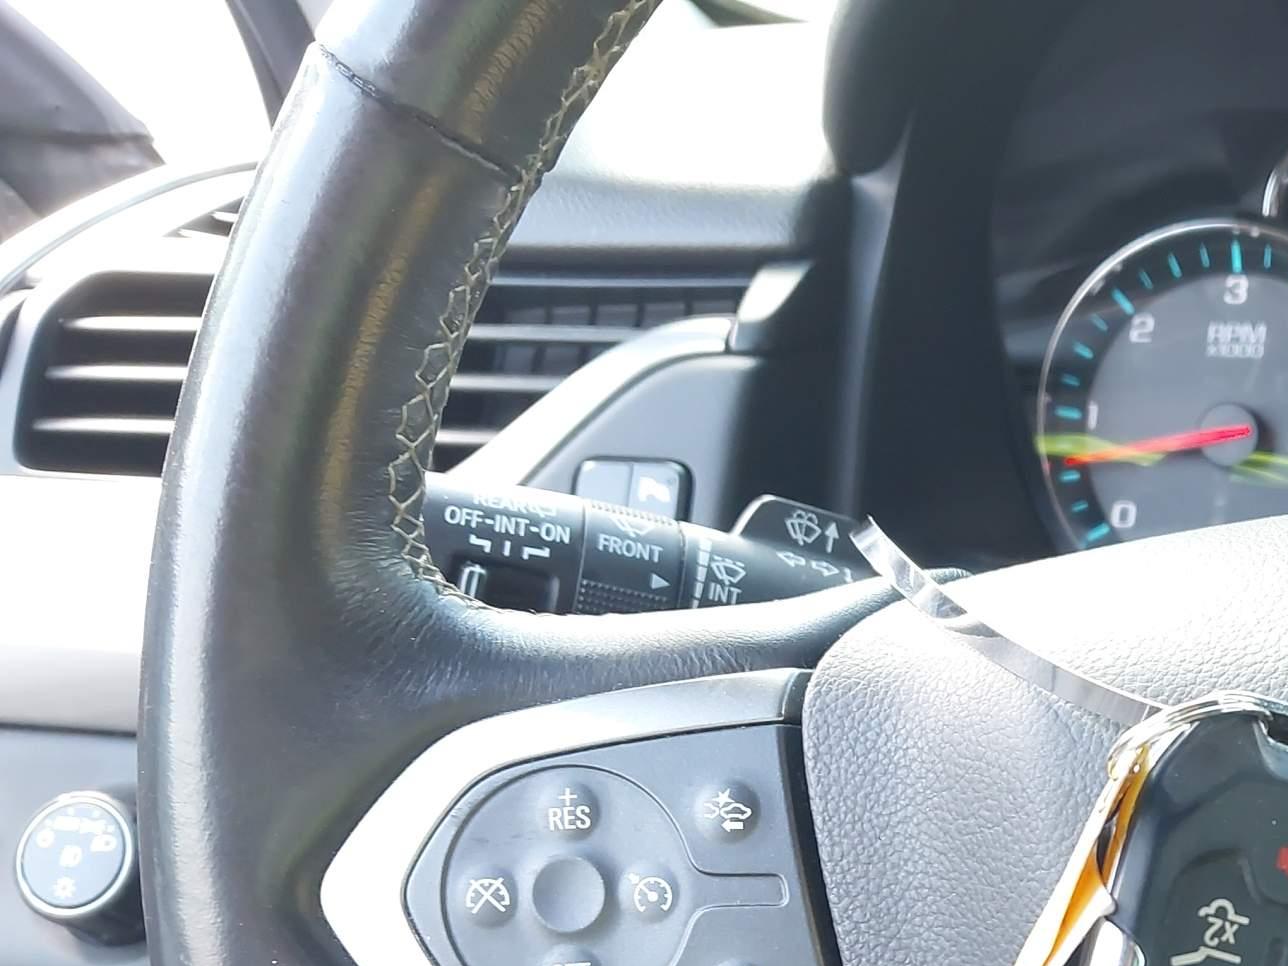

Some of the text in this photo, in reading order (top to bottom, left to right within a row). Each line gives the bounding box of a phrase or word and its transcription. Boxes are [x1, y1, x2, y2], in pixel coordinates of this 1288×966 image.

[1223, 275, 1249, 305] 3
[1128, 314, 1155, 343] 2
[1207, 321, 1267, 343] RPM
[1086, 401, 1100, 430] 1
[444, 505, 571, 545] OFF-INT-ON
[1110, 500, 1138, 529] 0
[597, 533, 664, 563] FRONT
[708, 582, 743, 606] INT
[548, 805, 592, 831] RES
